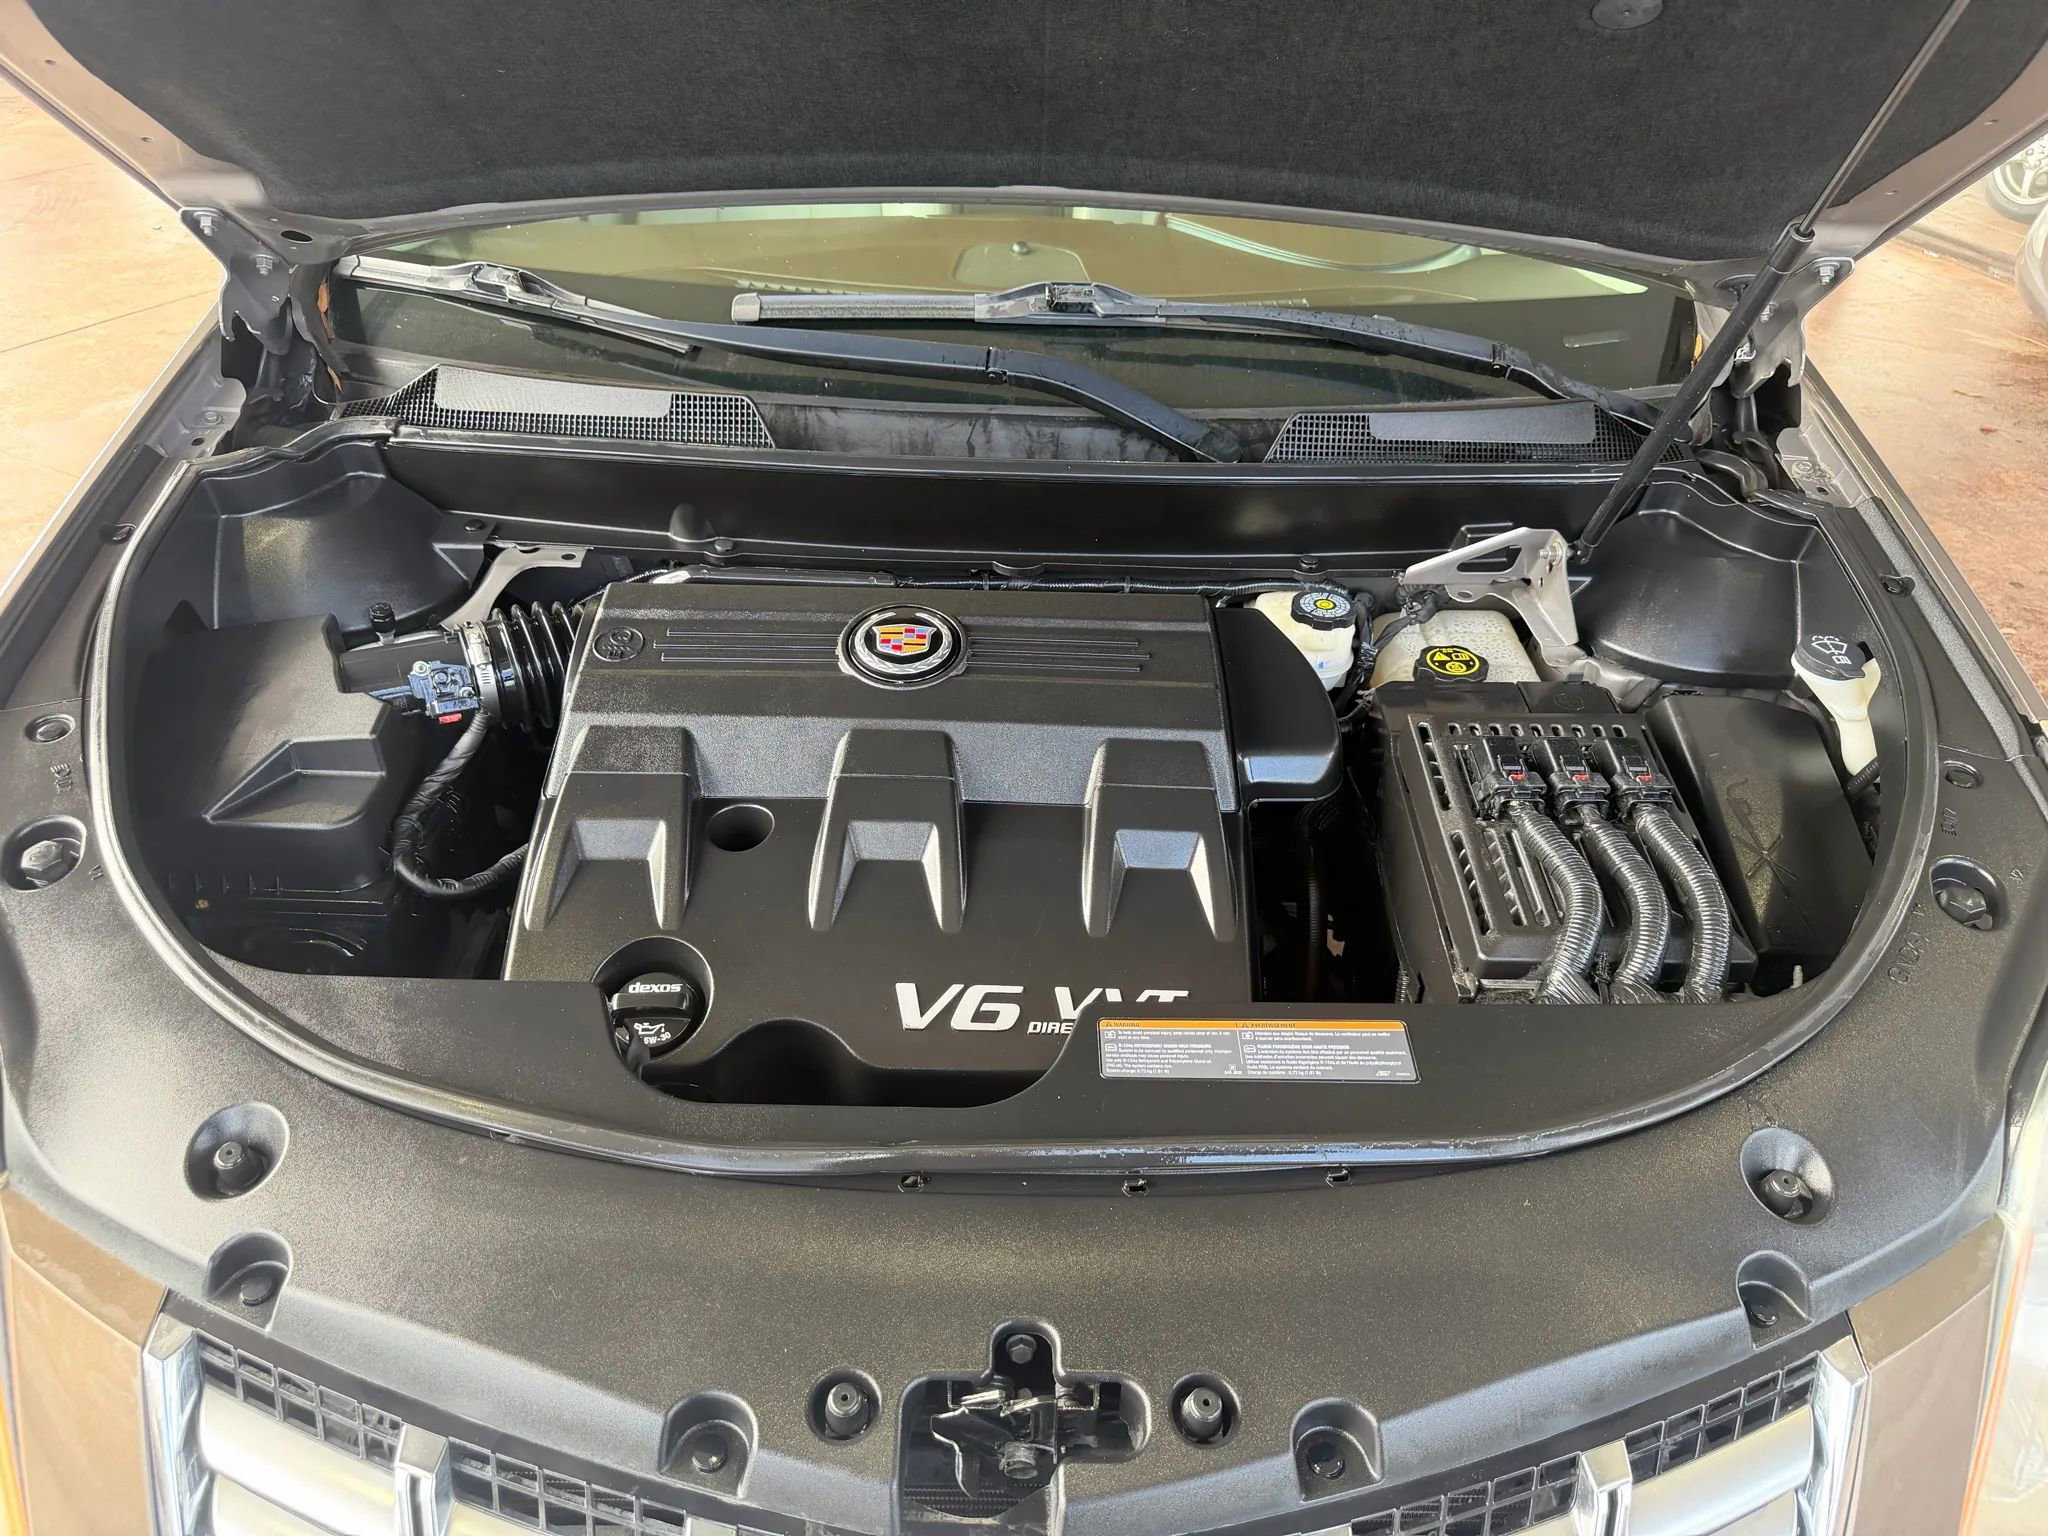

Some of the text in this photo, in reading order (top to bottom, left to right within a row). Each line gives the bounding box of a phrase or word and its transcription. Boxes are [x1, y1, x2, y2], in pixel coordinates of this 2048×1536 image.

[628, 982, 683, 993] dexos
[895, 982, 1025, 1031] V6
[644, 1031, 672, 1045] 5W-30
